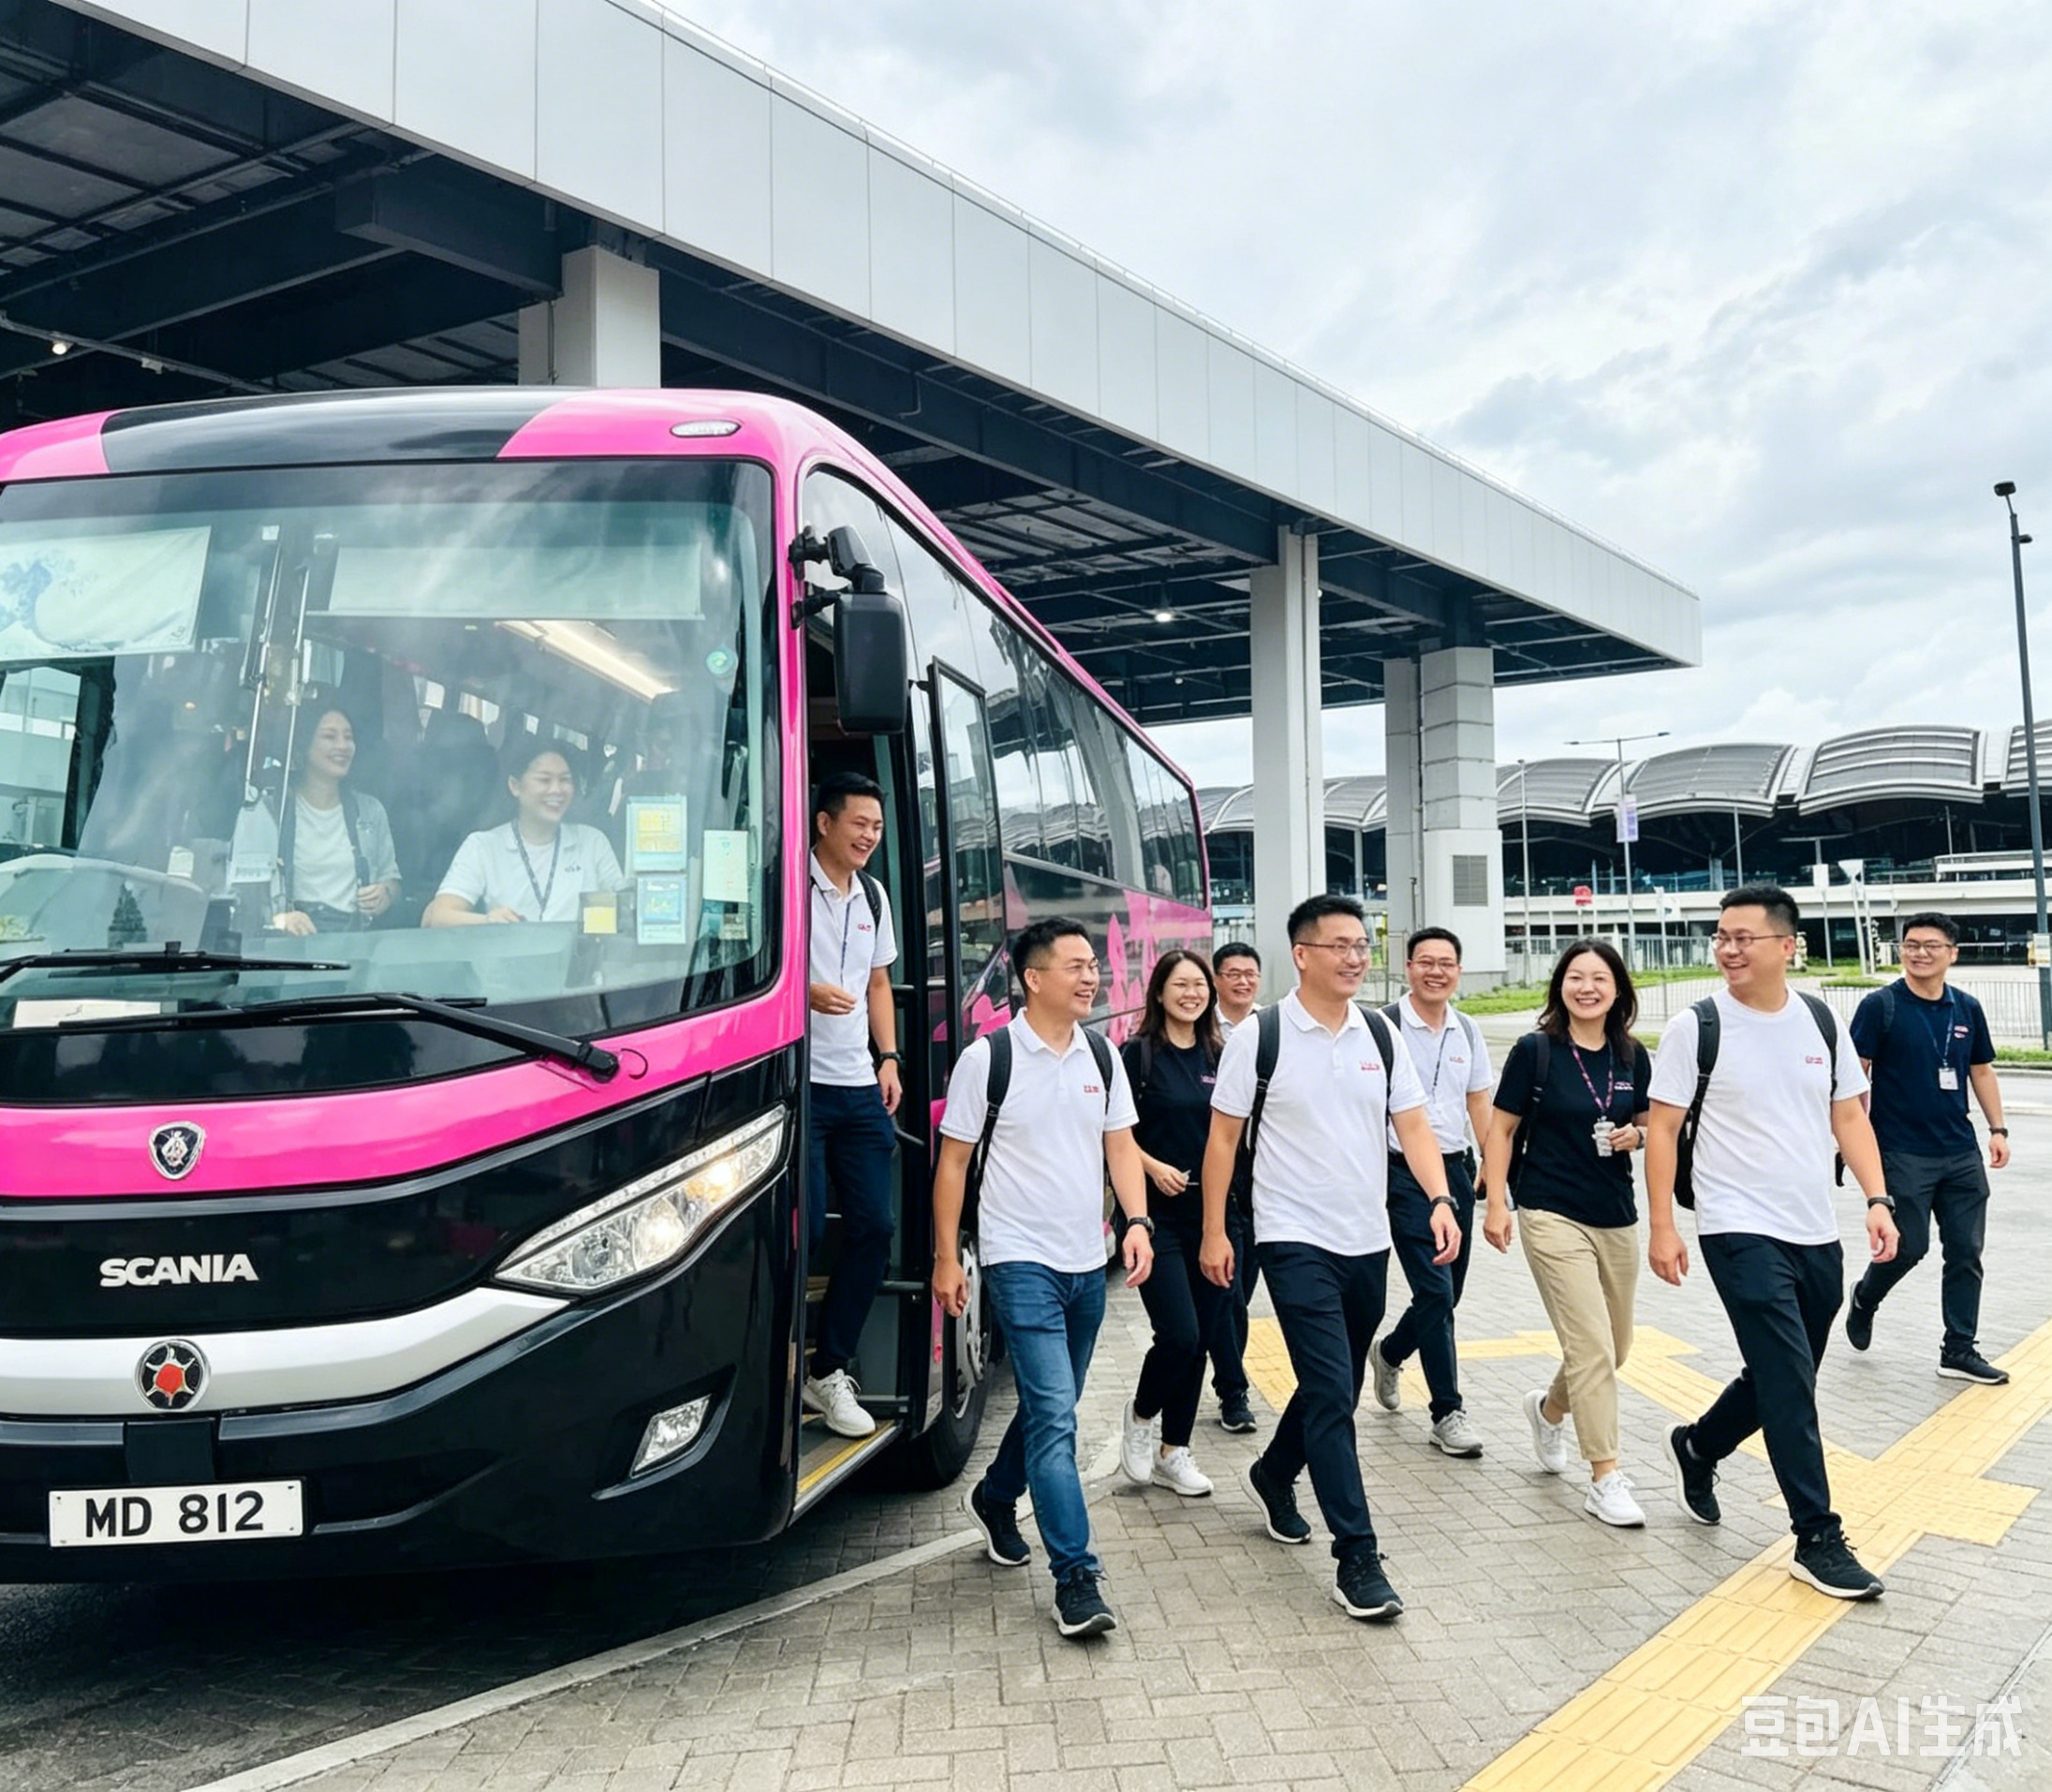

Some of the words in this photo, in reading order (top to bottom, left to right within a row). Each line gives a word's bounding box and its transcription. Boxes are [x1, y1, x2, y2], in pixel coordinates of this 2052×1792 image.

[99, 1253, 259, 1287] SCANIA
[85, 1496, 153, 1537] MD
[178, 1490, 264, 1533] 812
